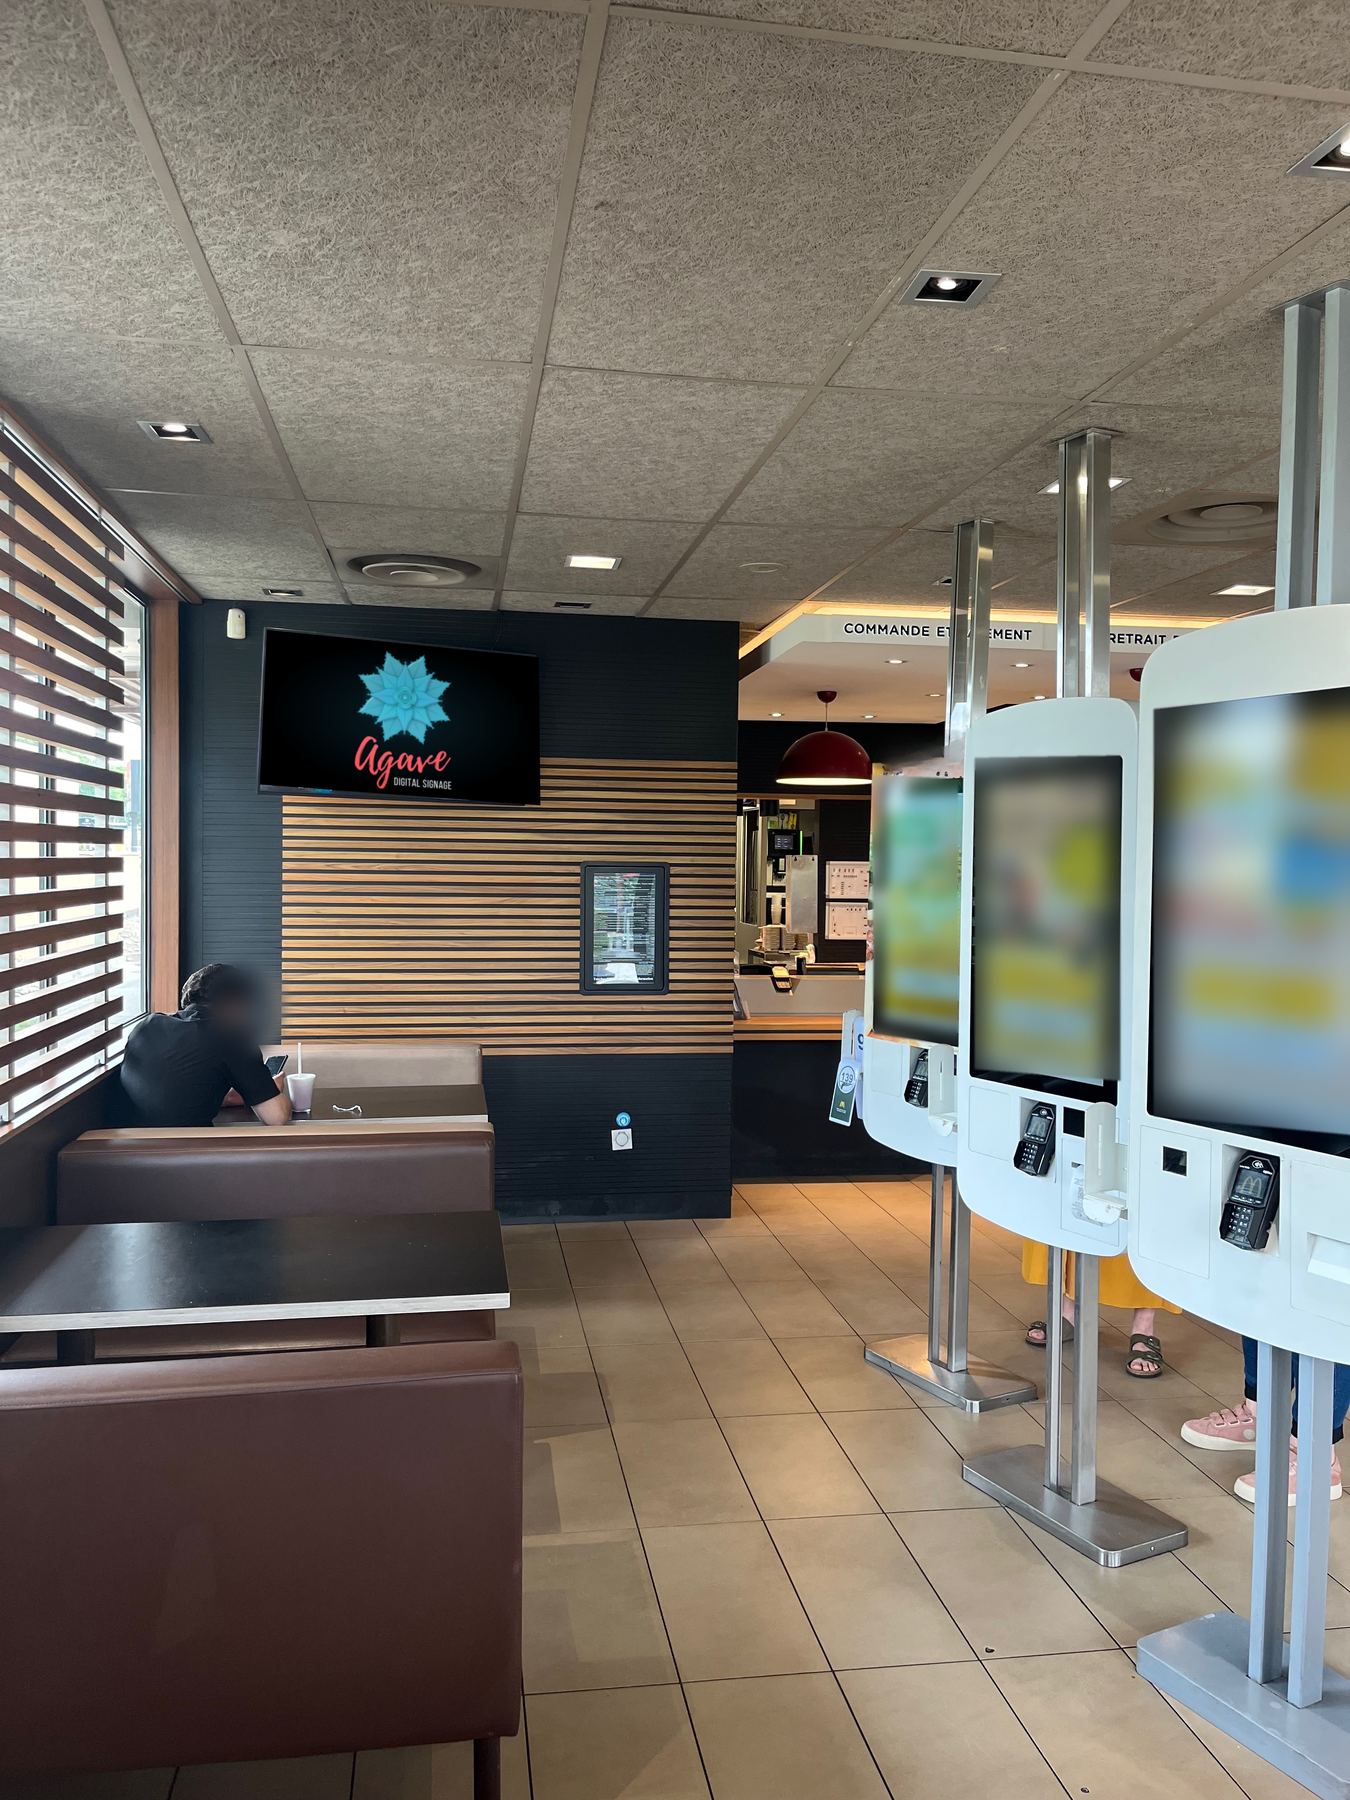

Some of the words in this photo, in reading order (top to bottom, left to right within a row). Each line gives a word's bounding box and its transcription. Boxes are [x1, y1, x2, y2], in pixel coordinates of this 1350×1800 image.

[844, 623, 930, 637] COMMANDE
[1109, 633, 1166, 645] RETRAIT
[354, 735, 451, 790] Agave
[393, 777, 420, 788] DIGITAL
[422, 779, 452, 790] SIGNAGE
